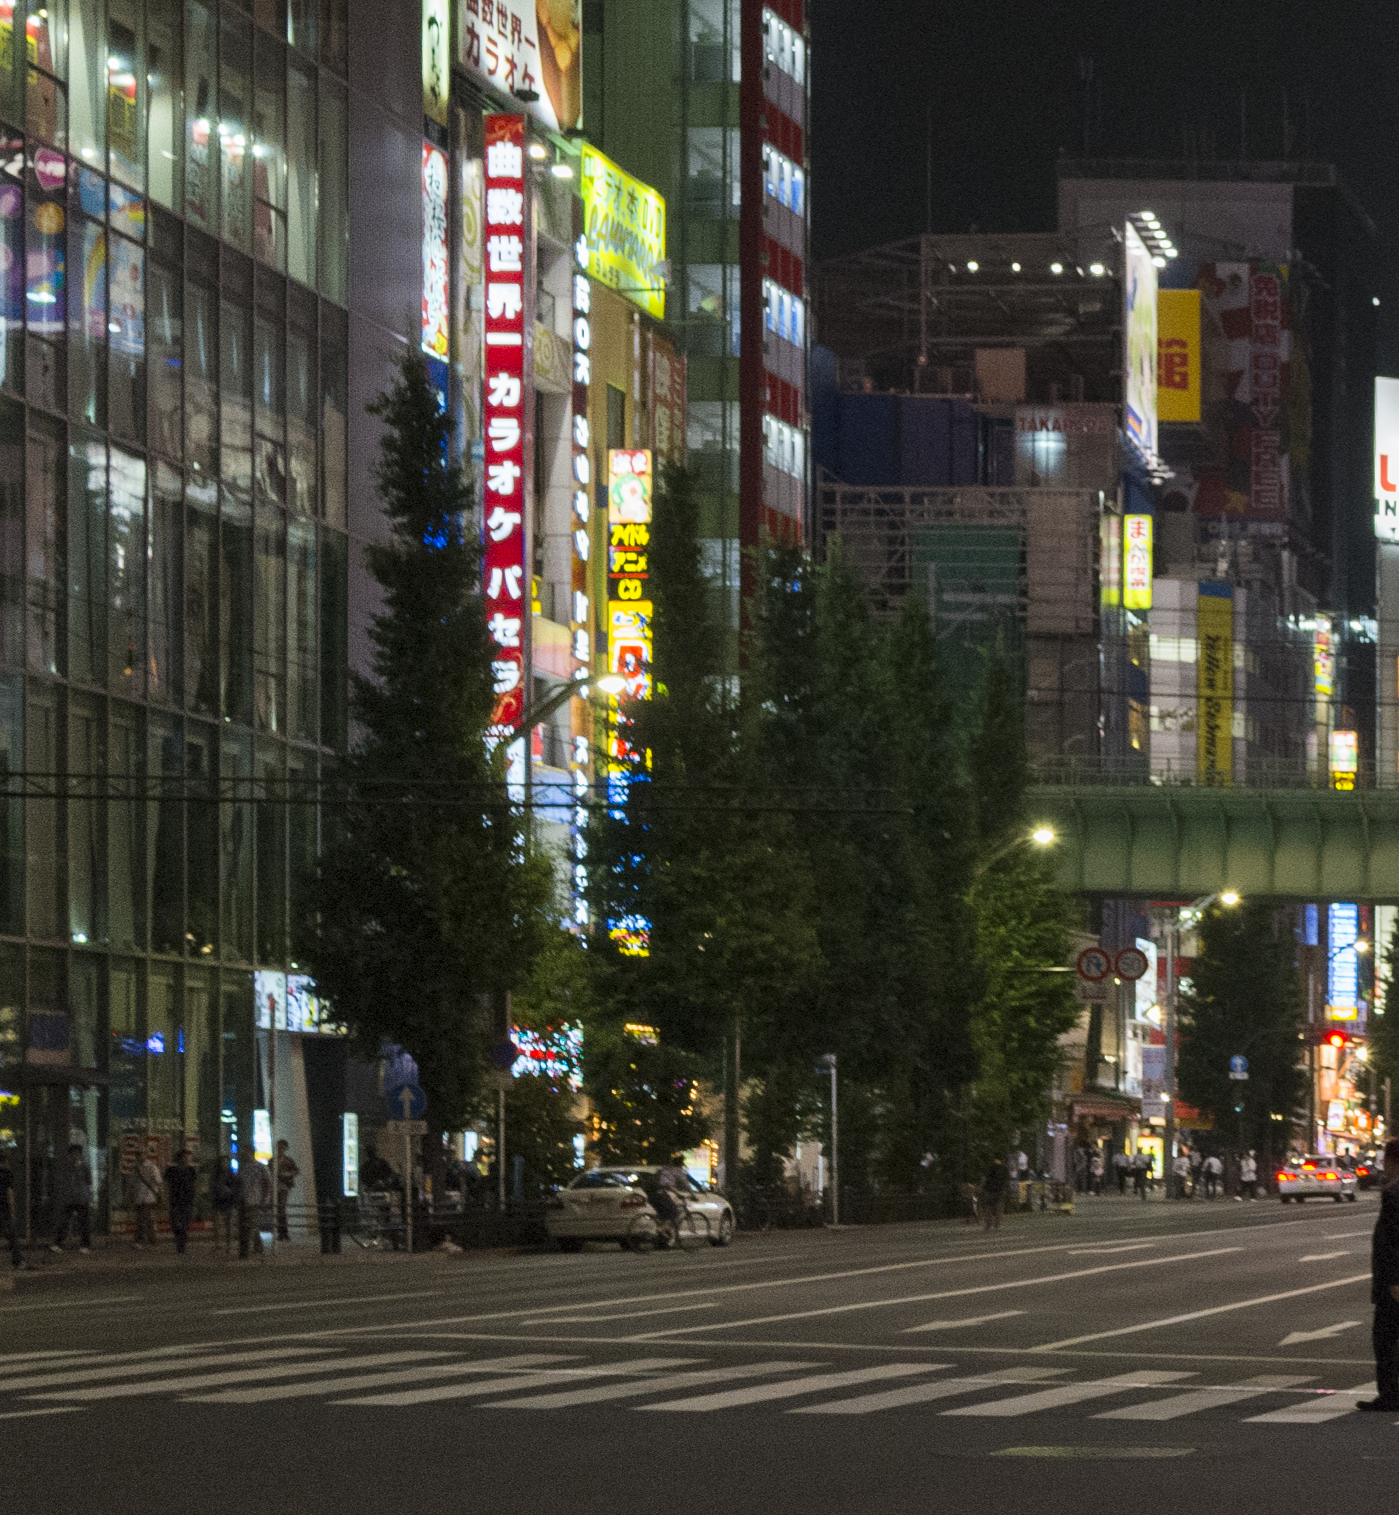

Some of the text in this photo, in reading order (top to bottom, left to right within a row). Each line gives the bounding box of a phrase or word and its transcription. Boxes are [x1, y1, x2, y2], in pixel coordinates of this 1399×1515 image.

[465, 21, 536, 94] カラオケ
[611, 551, 649, 573] アニメ
[616, 578, 642, 601] CD
